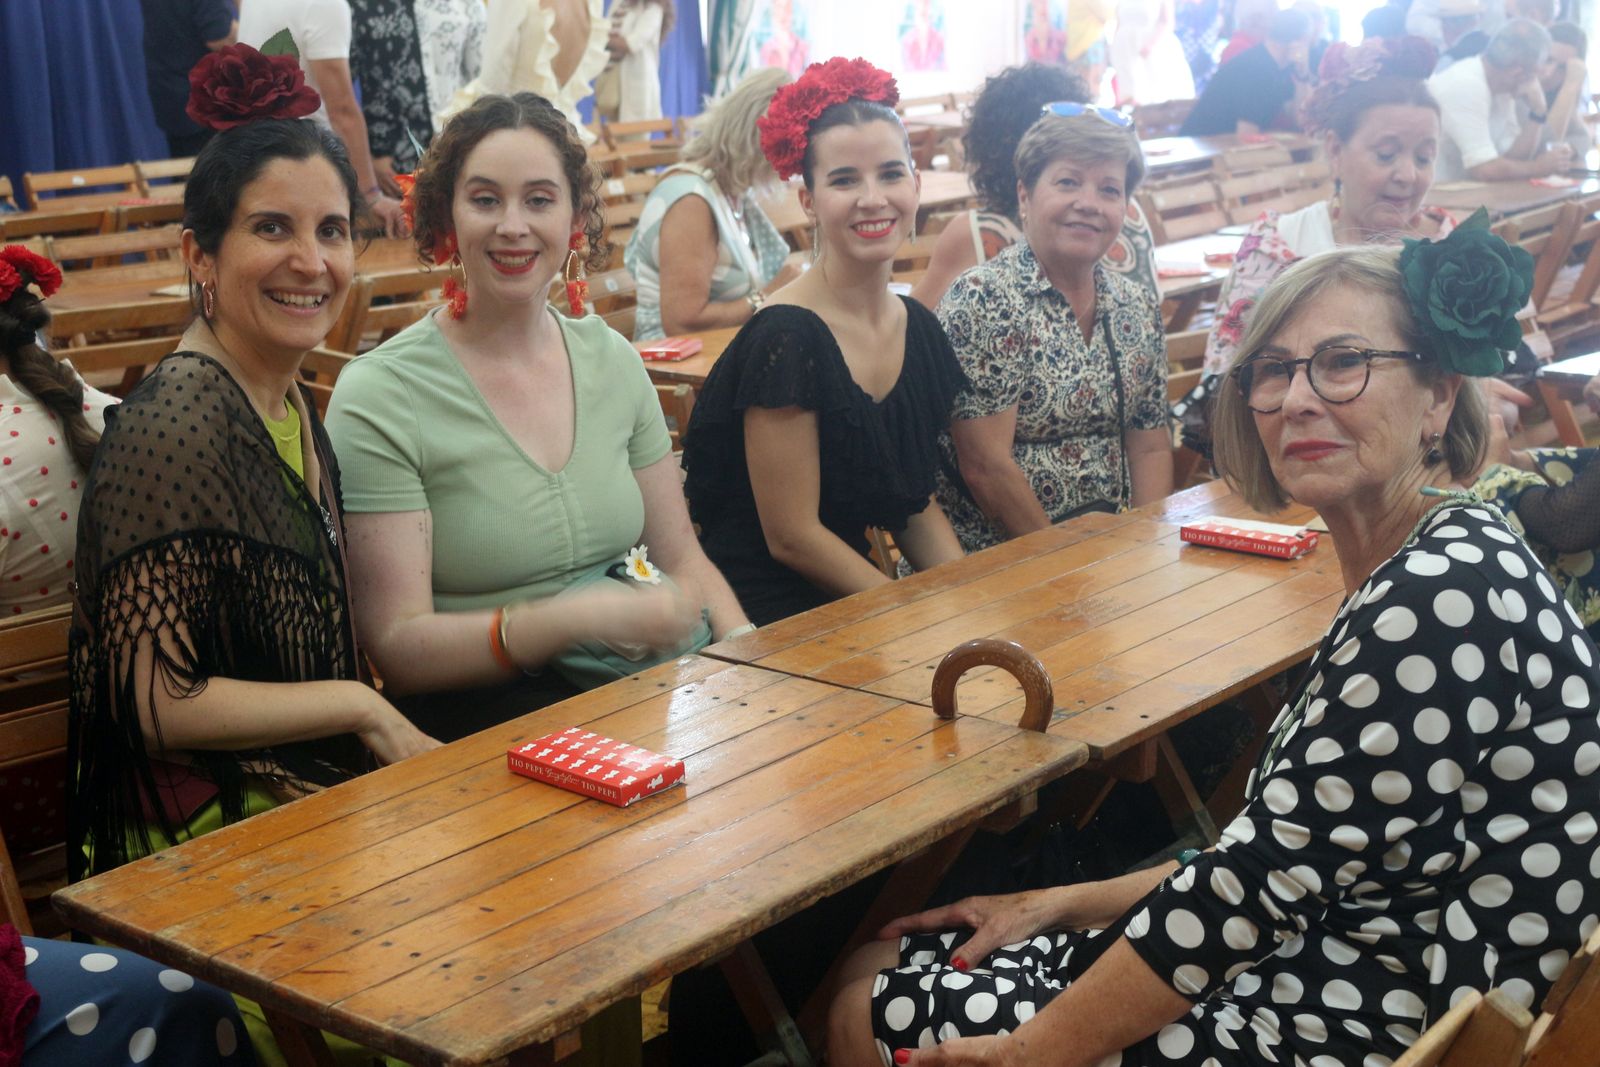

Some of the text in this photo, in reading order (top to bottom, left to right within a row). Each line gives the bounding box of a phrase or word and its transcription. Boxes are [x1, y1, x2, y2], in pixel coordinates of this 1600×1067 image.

[1184, 532, 1197, 541] TIO
[1198, 534, 1217, 543] PEPE
[1267, 546, 1286, 554] PEPE
[510, 758, 616, 799] TIO PEPE TIO PEPE
